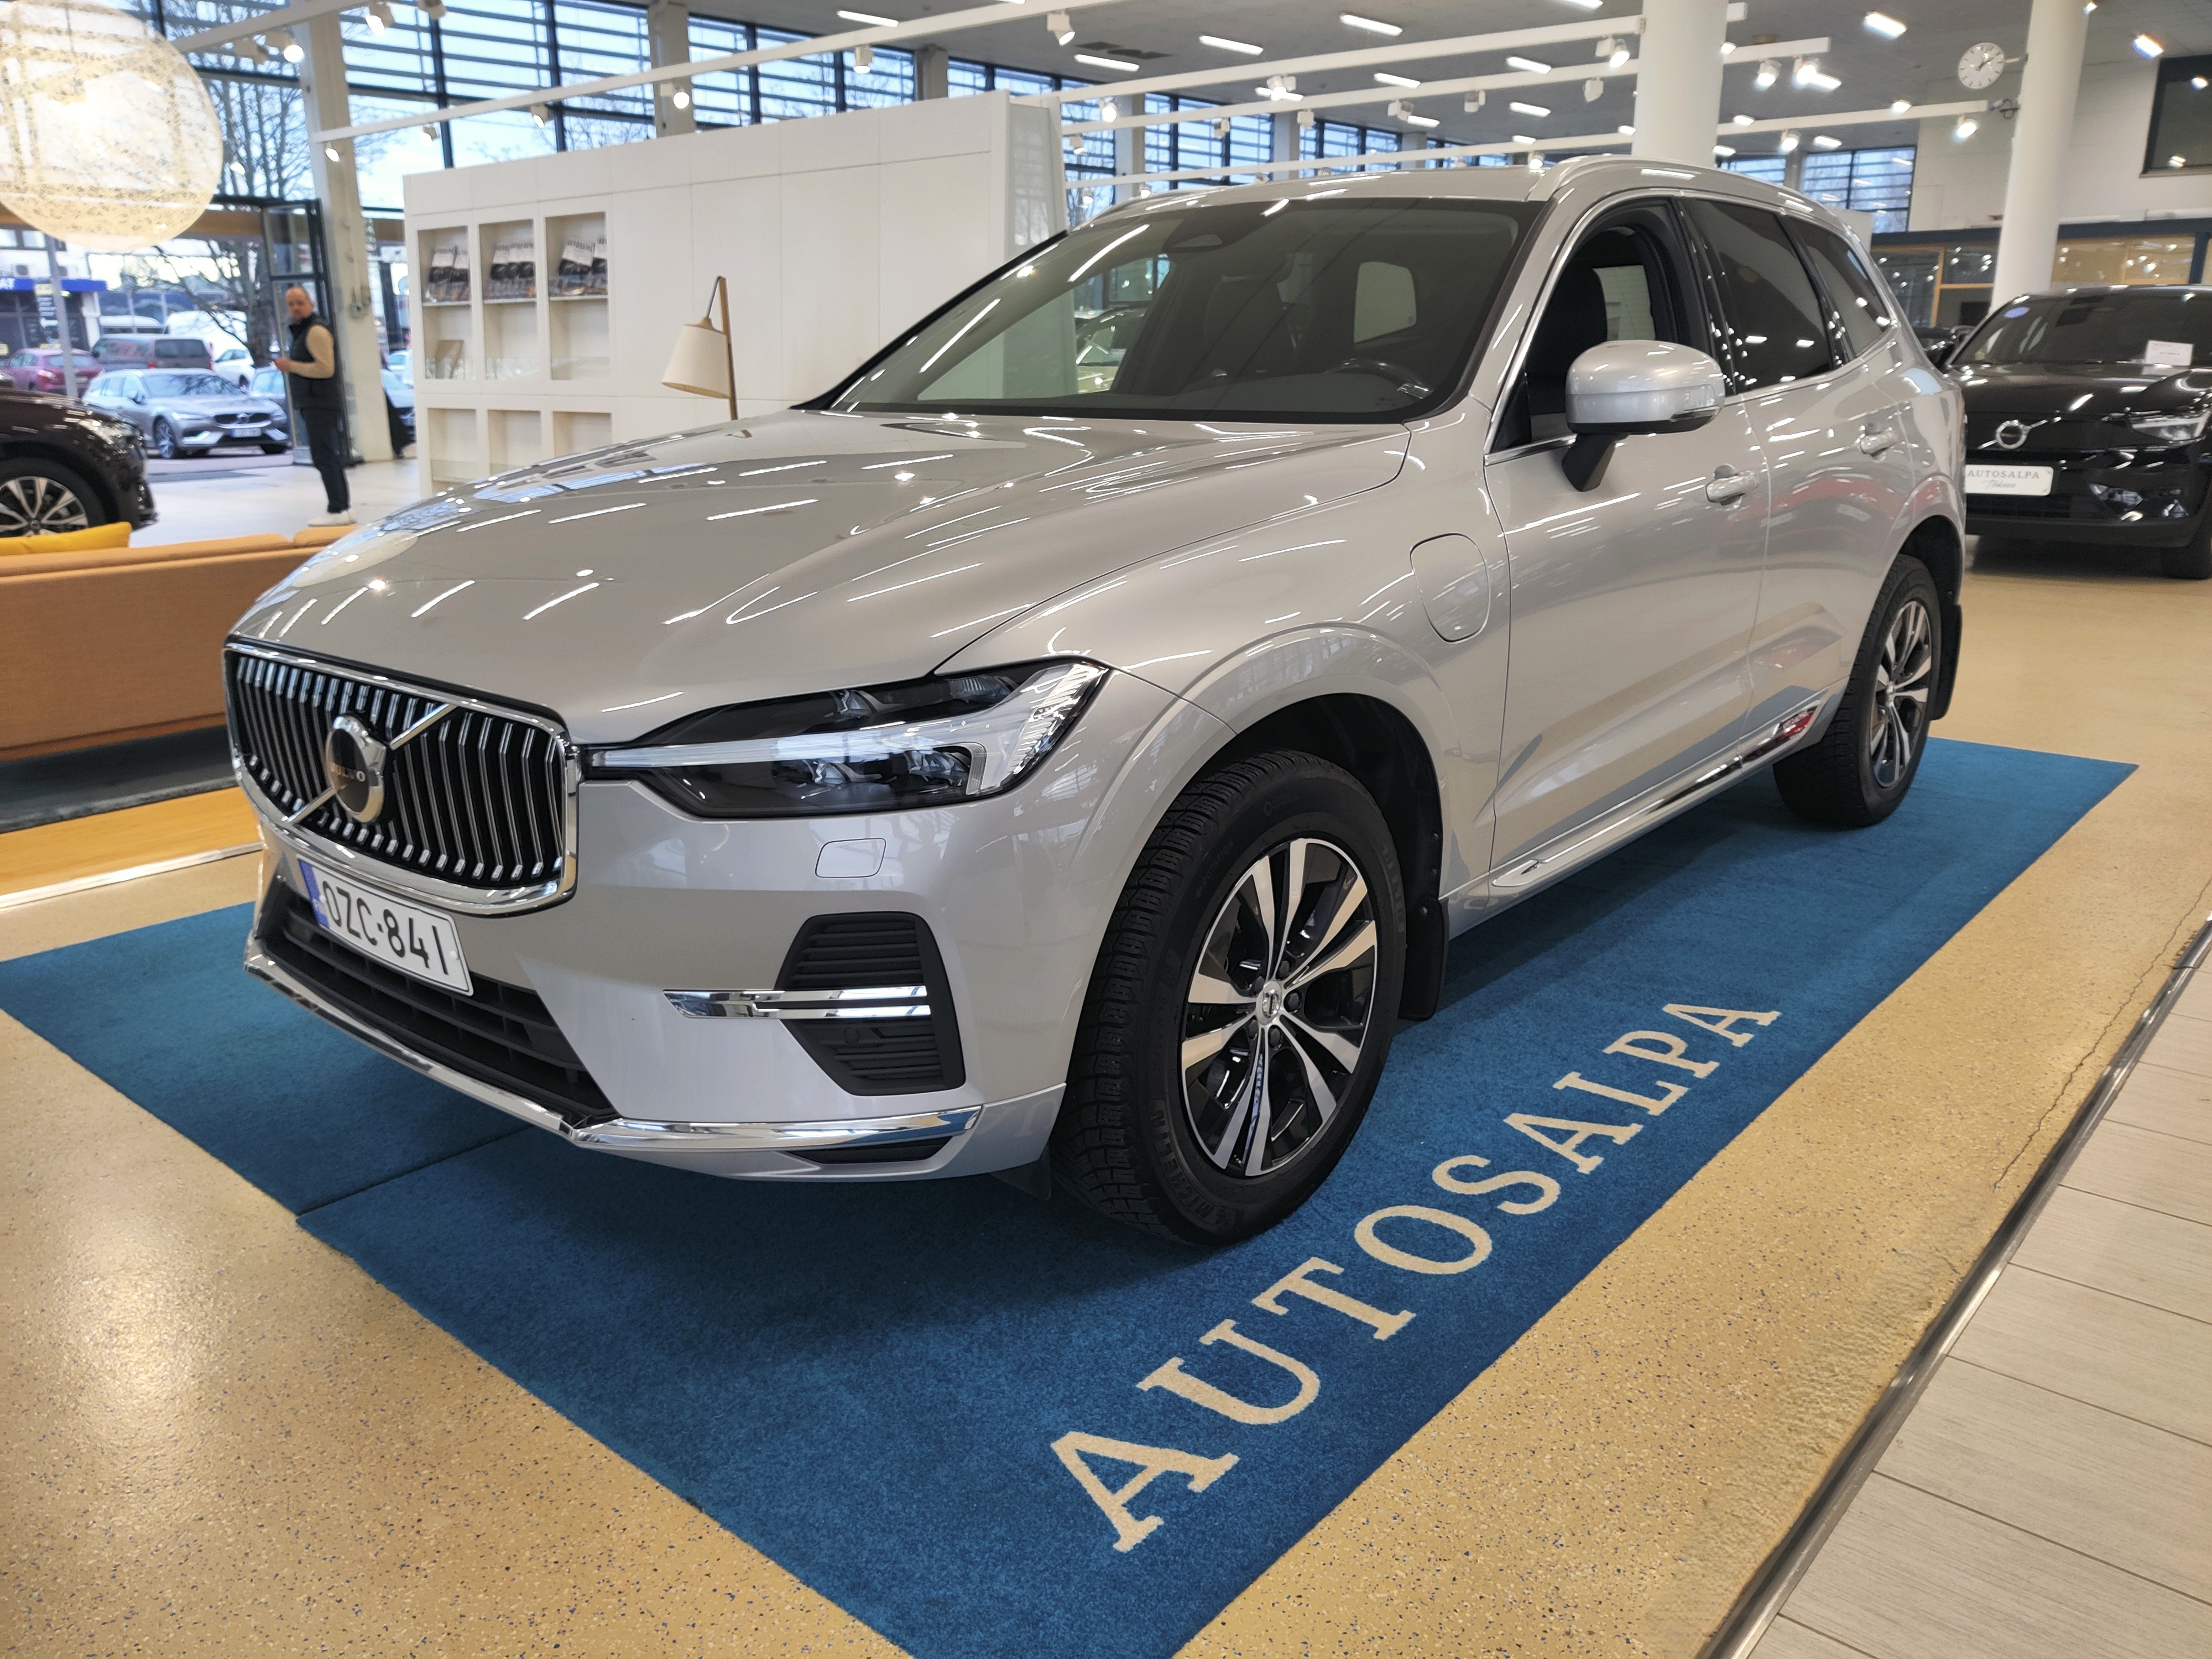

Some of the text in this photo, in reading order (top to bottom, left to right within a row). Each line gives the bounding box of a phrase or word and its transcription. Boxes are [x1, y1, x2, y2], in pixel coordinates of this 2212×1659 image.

[1968, 470, 2039, 479] AUTOSALPA
[322, 880, 449, 975] OZC-841
[1152, 1109, 1215, 1217] MICHELIN
[1051, 1003, 1782, 1553] AUTOSALPA
